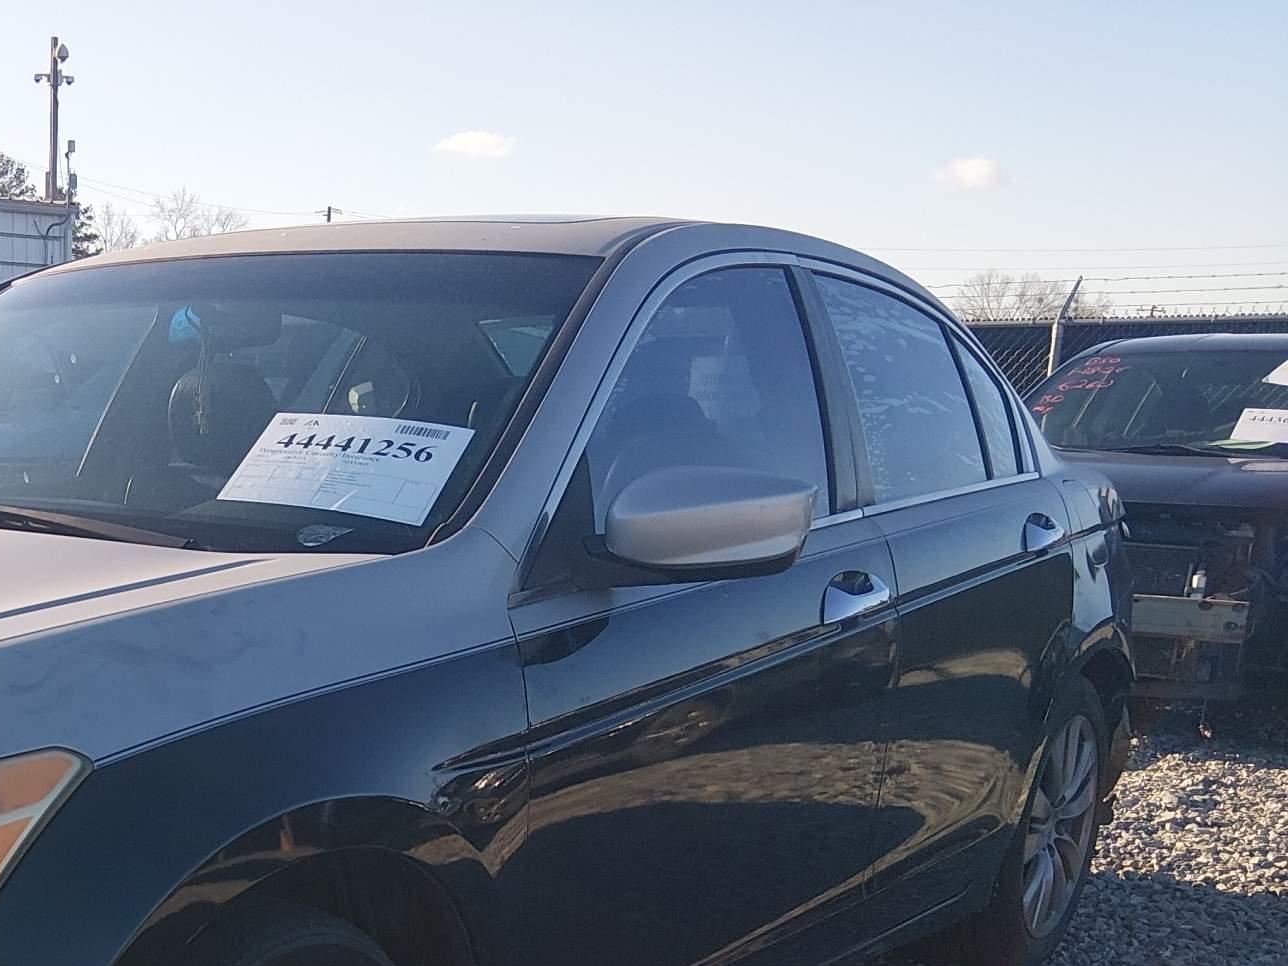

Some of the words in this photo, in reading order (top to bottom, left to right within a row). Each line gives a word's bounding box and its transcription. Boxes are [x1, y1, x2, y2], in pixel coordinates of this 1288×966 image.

[276, 432, 440, 463] 44441256
[304, 449, 339, 459] Casualty
[342, 452, 381, 463] Insurance
